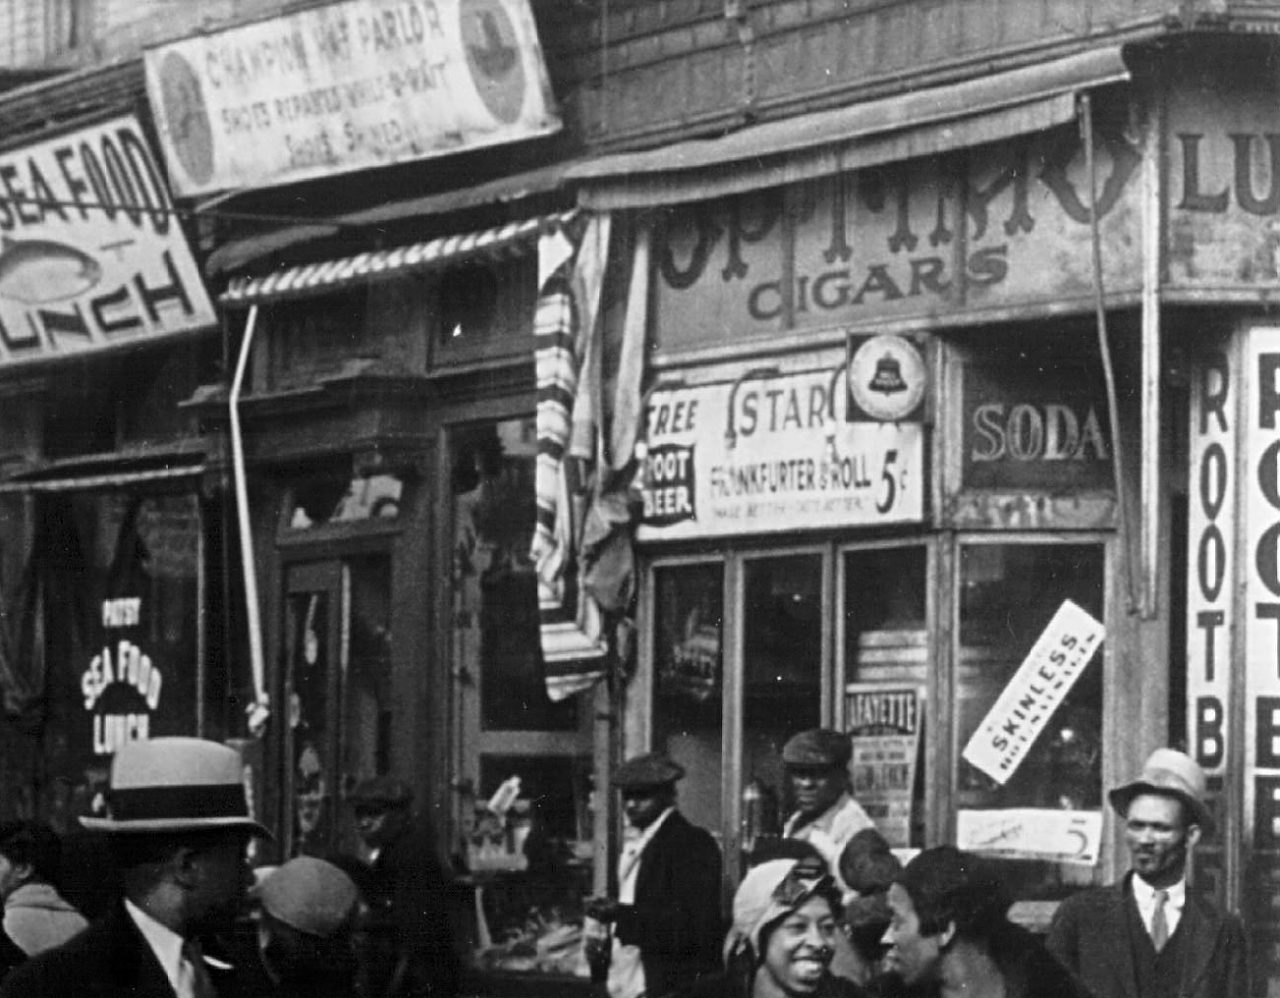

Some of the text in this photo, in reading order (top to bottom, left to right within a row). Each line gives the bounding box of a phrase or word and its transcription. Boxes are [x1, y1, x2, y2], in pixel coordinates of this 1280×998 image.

[54, 127, 171, 236] FOOD
[747, 244, 1009, 322] CIGARS
[971, 403, 1109, 462] SODA
[991, 633, 1078, 752] SKINLESS
